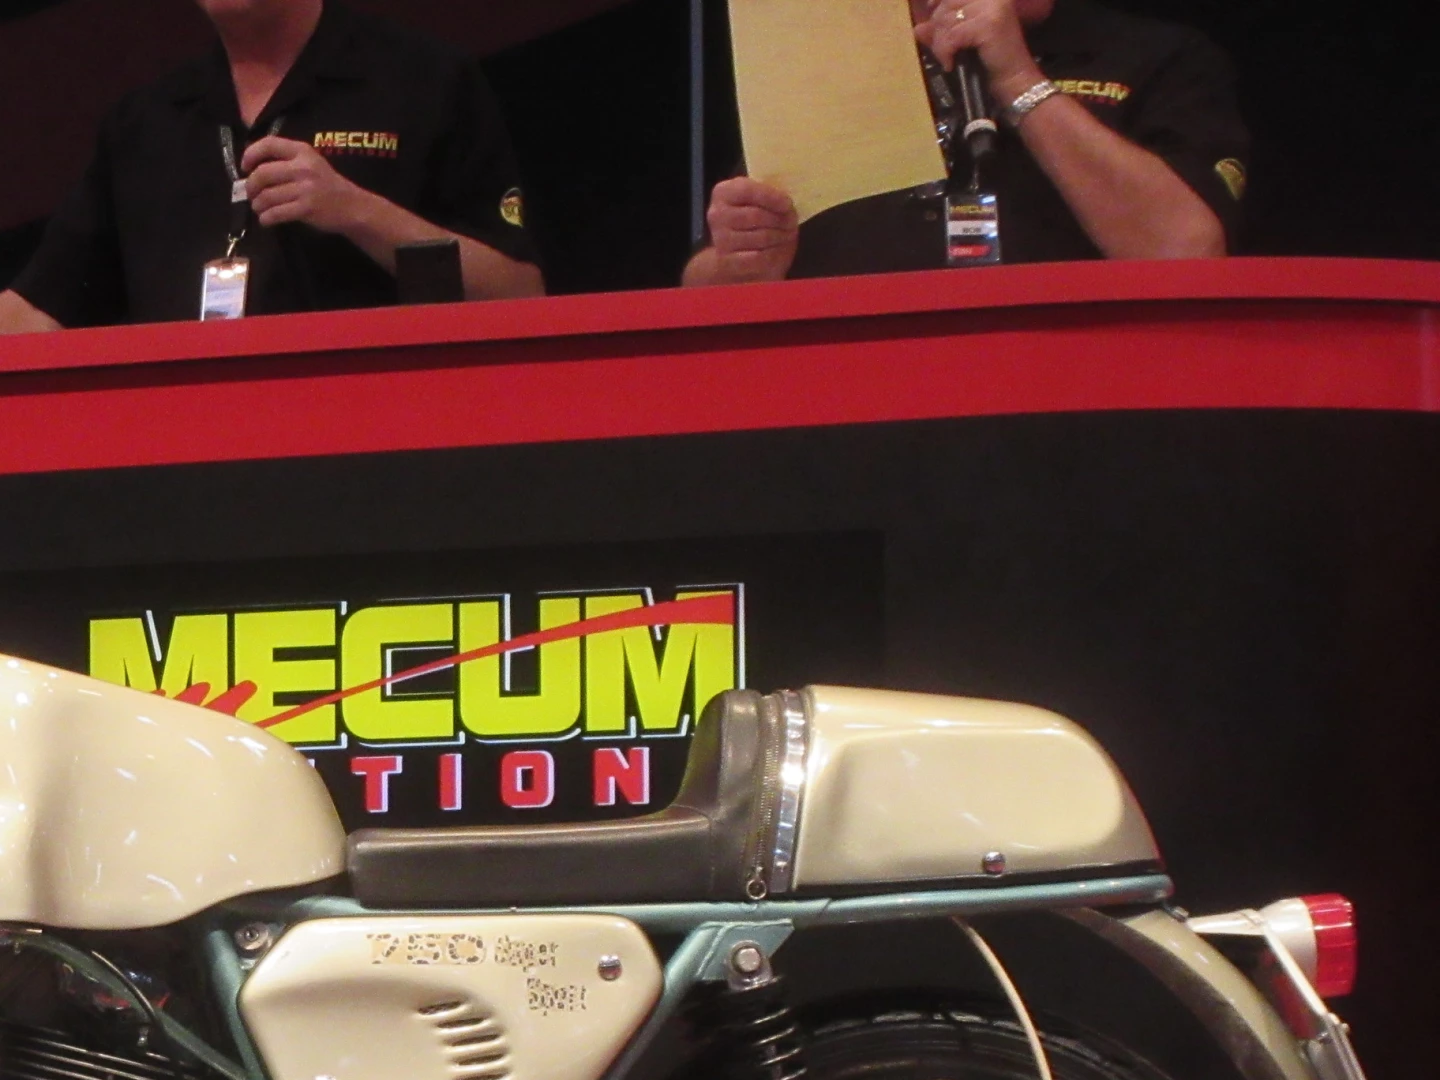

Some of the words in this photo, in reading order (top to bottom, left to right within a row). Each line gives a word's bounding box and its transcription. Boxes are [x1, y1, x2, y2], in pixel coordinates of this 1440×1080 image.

[314, 131, 398, 150] MECUM
[89, 583, 745, 749] MECUM
[308, 747, 650, 813] TION
[366, 932, 488, 966] 750
